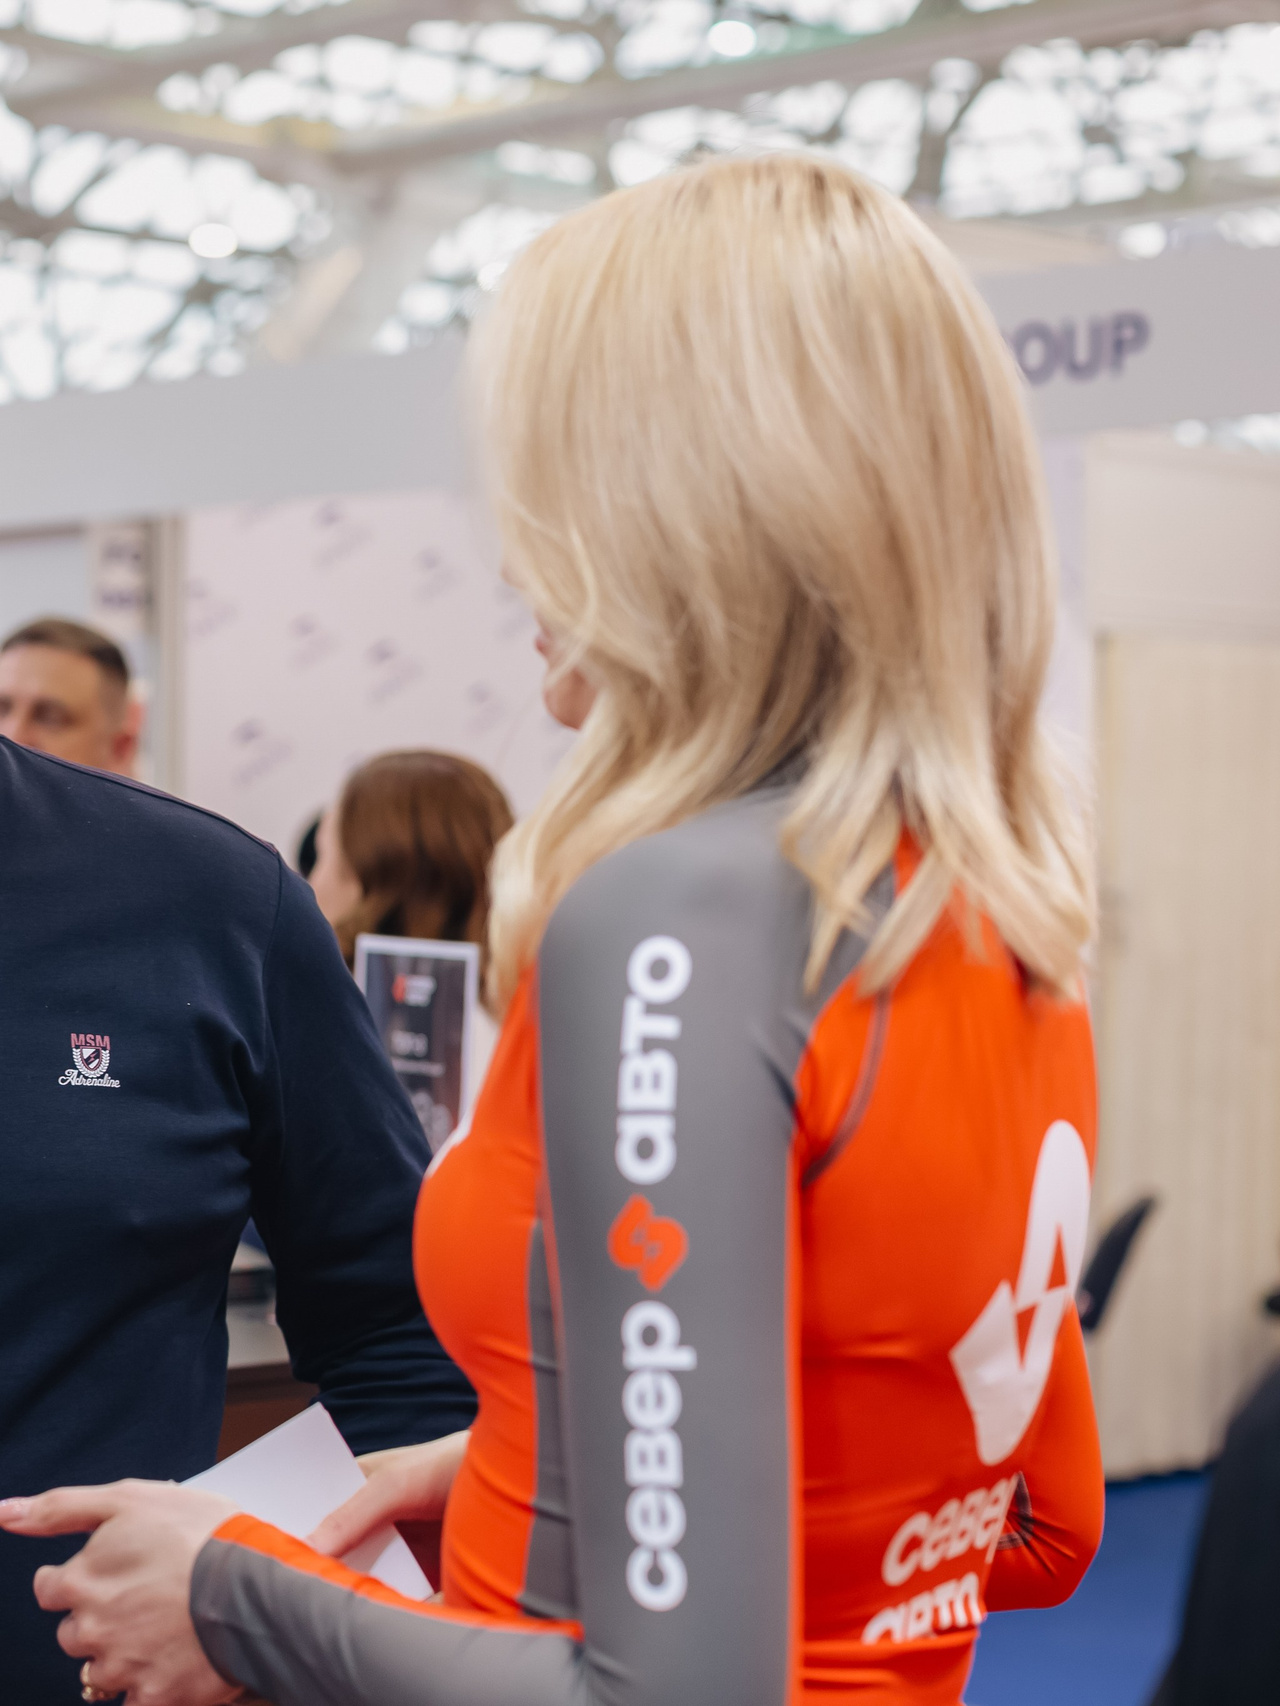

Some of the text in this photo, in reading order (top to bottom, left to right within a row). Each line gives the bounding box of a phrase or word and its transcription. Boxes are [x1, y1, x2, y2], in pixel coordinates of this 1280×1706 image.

[1004, 308, 1151, 387] OUP
[71, 1033, 111, 1051] MSM
[58, 1069, 121, 1088] Adrenaline
[615, 935, 697, 1611] север авто
